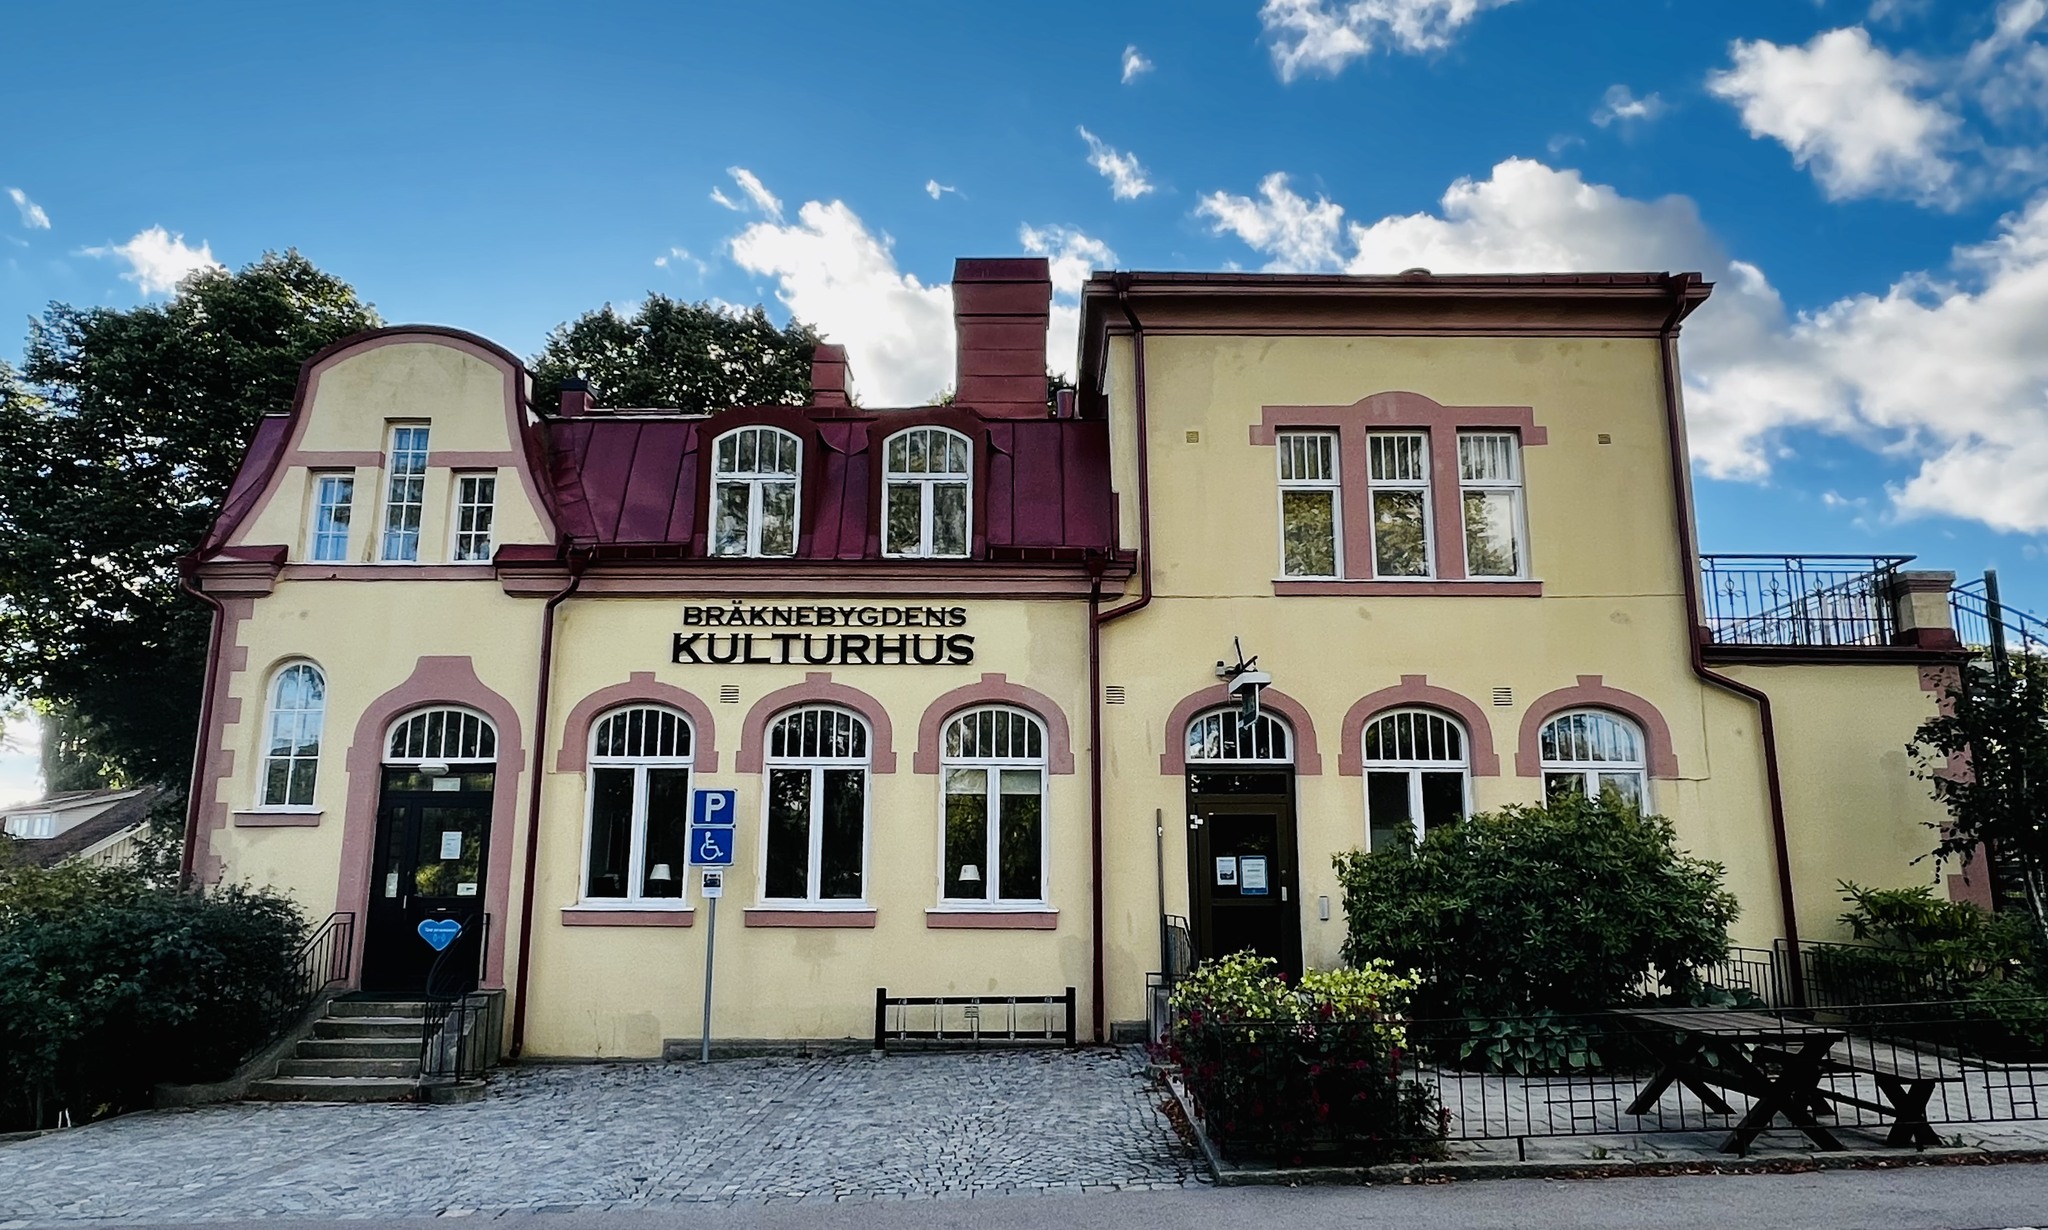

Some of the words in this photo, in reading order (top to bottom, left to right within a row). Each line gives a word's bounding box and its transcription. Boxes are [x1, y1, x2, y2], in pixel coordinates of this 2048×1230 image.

[683, 600, 967, 626] BRÄKNEBYGDENS
[671, 632, 975, 664] KULTURHUS
[705, 793, 726, 822] P
